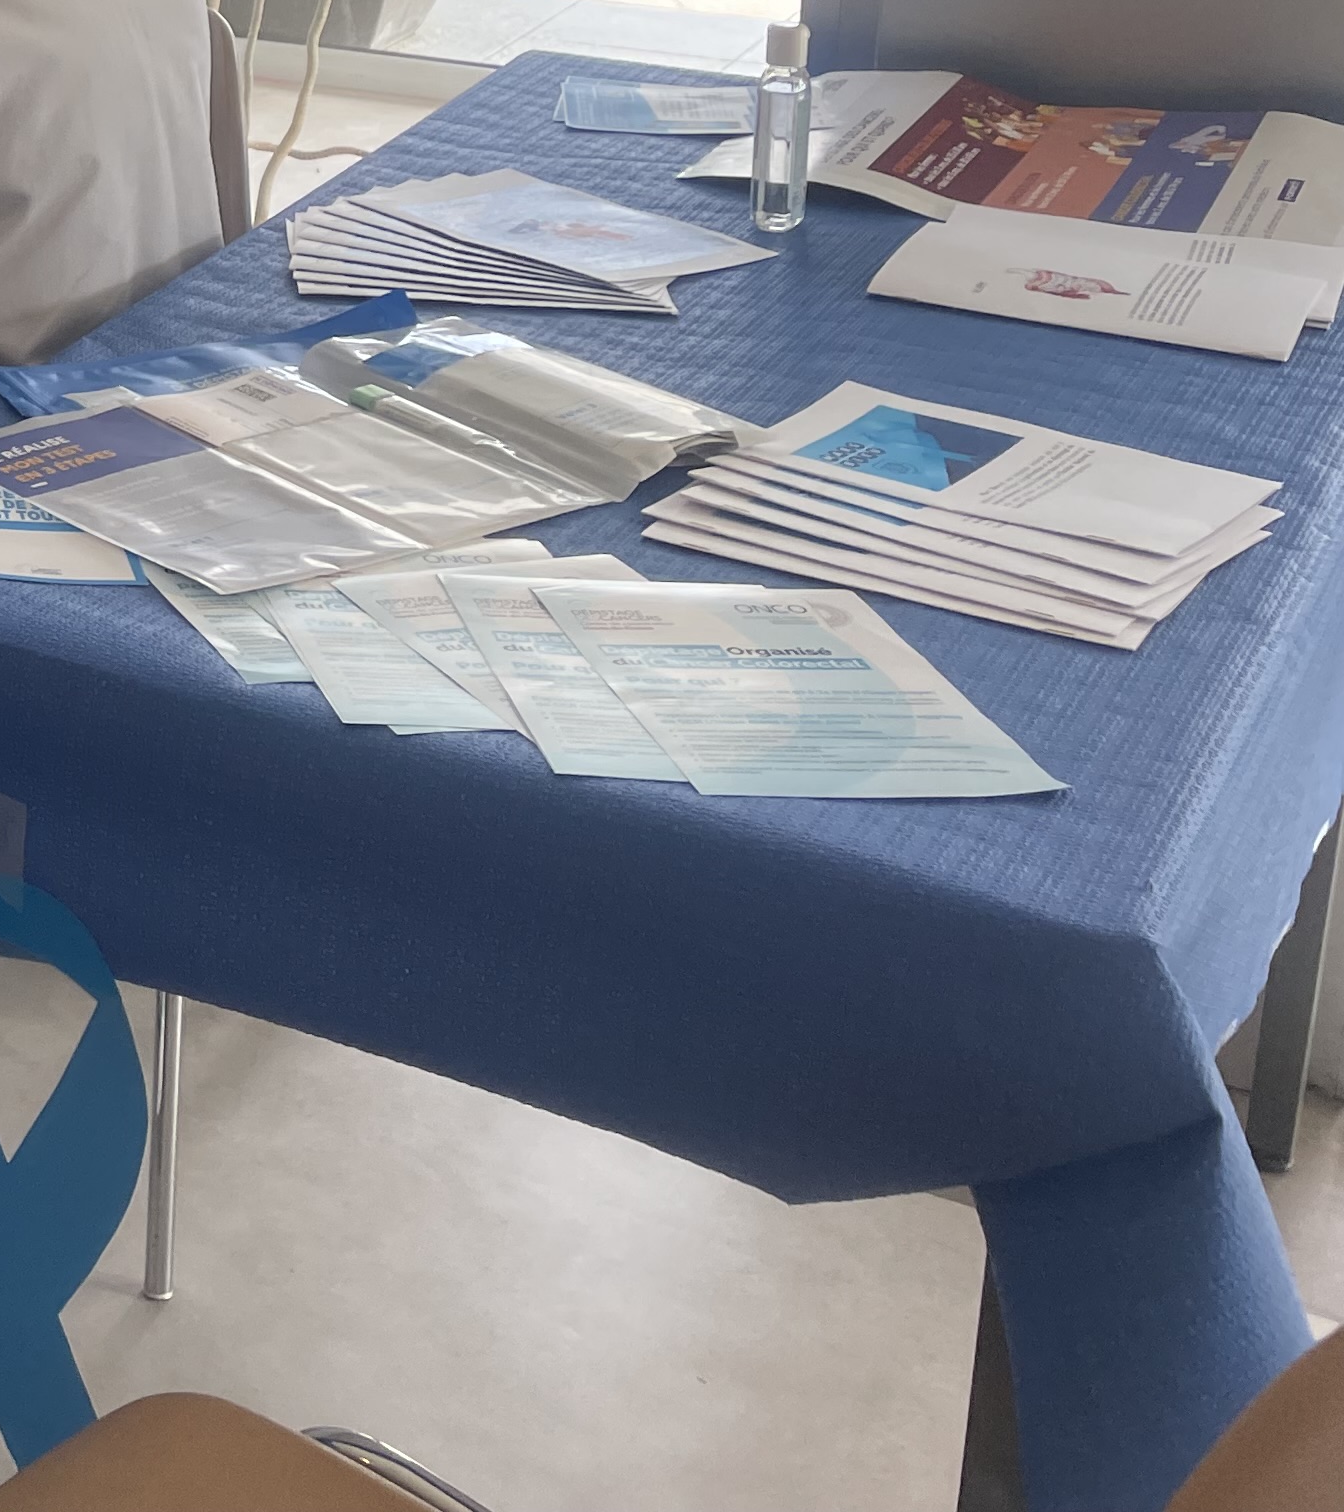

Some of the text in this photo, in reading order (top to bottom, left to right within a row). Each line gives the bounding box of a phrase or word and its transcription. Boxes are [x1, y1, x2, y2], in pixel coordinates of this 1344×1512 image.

[0, 435, 71, 460] RÉALISE
[0, 444, 84, 474] MON TEST
[15, 470, 44, 483] EN
[54, 449, 118, 471] ÉTAPES
[4, 499, 26, 510] DE
[16, 510, 61, 522] TOU
[422, 554, 493, 564] ONCO
[733, 603, 808, 615] ONCO
[725, 644, 833, 659] Organisé
[611, 657, 643, 666] du
[737, 657, 866, 670] Colorectal
